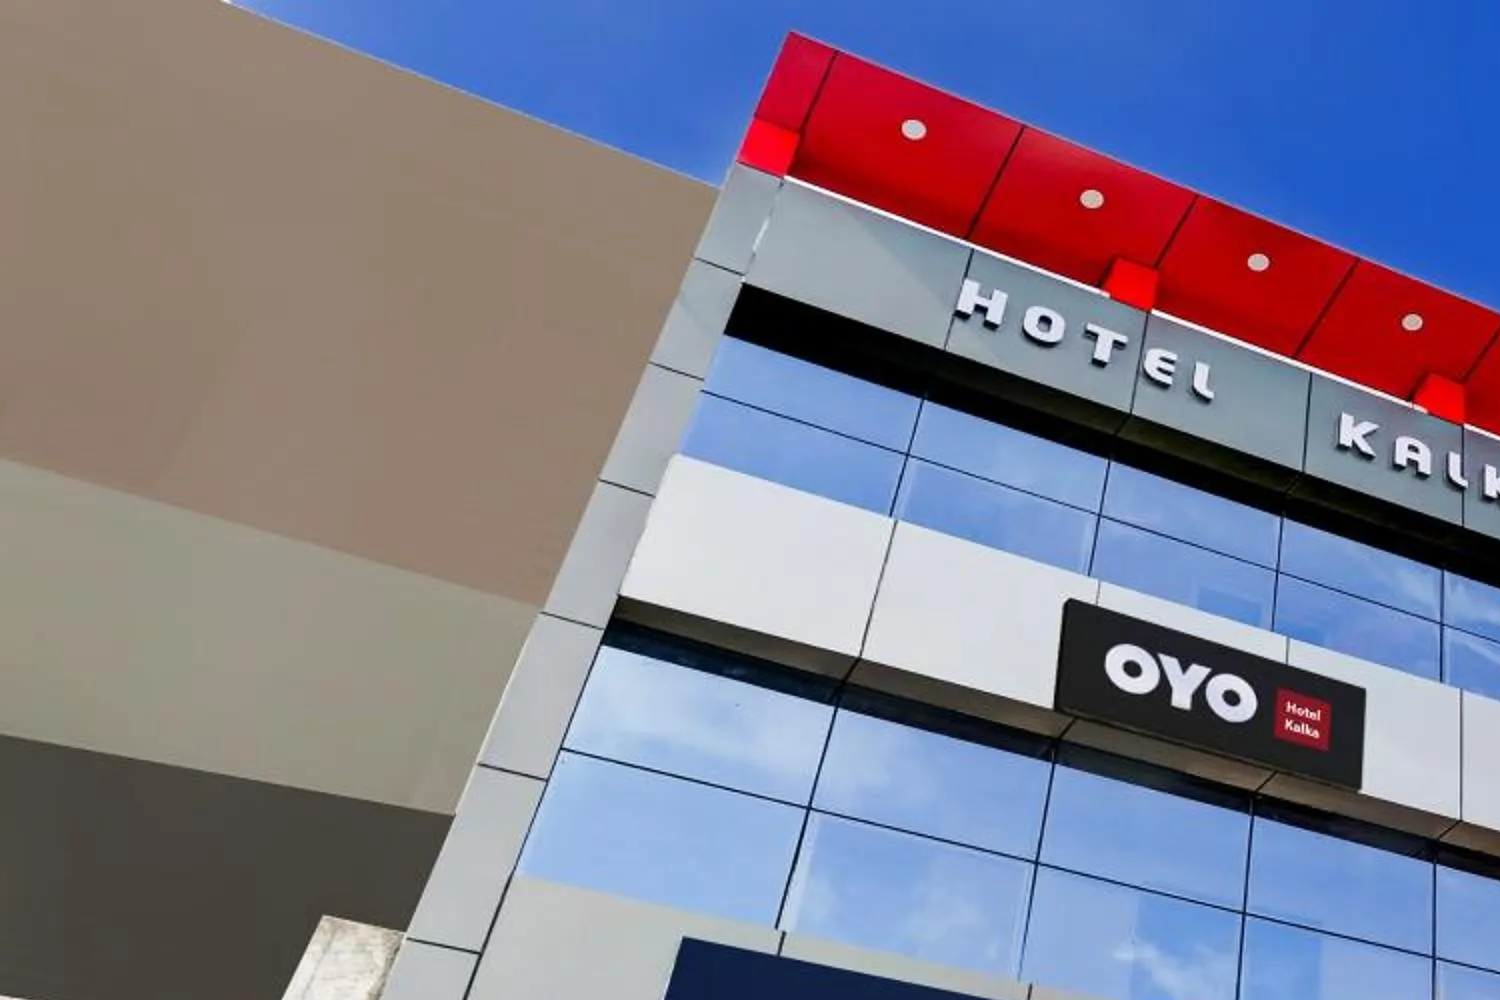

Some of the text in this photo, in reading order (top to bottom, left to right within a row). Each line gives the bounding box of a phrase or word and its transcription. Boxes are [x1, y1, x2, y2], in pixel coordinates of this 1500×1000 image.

[954, 278, 1215, 402] HOTEL
[1104, 643, 1259, 723] OYO
[1284, 719, 1320, 739] Kalka
[1286, 700, 1321, 722] Hotel
